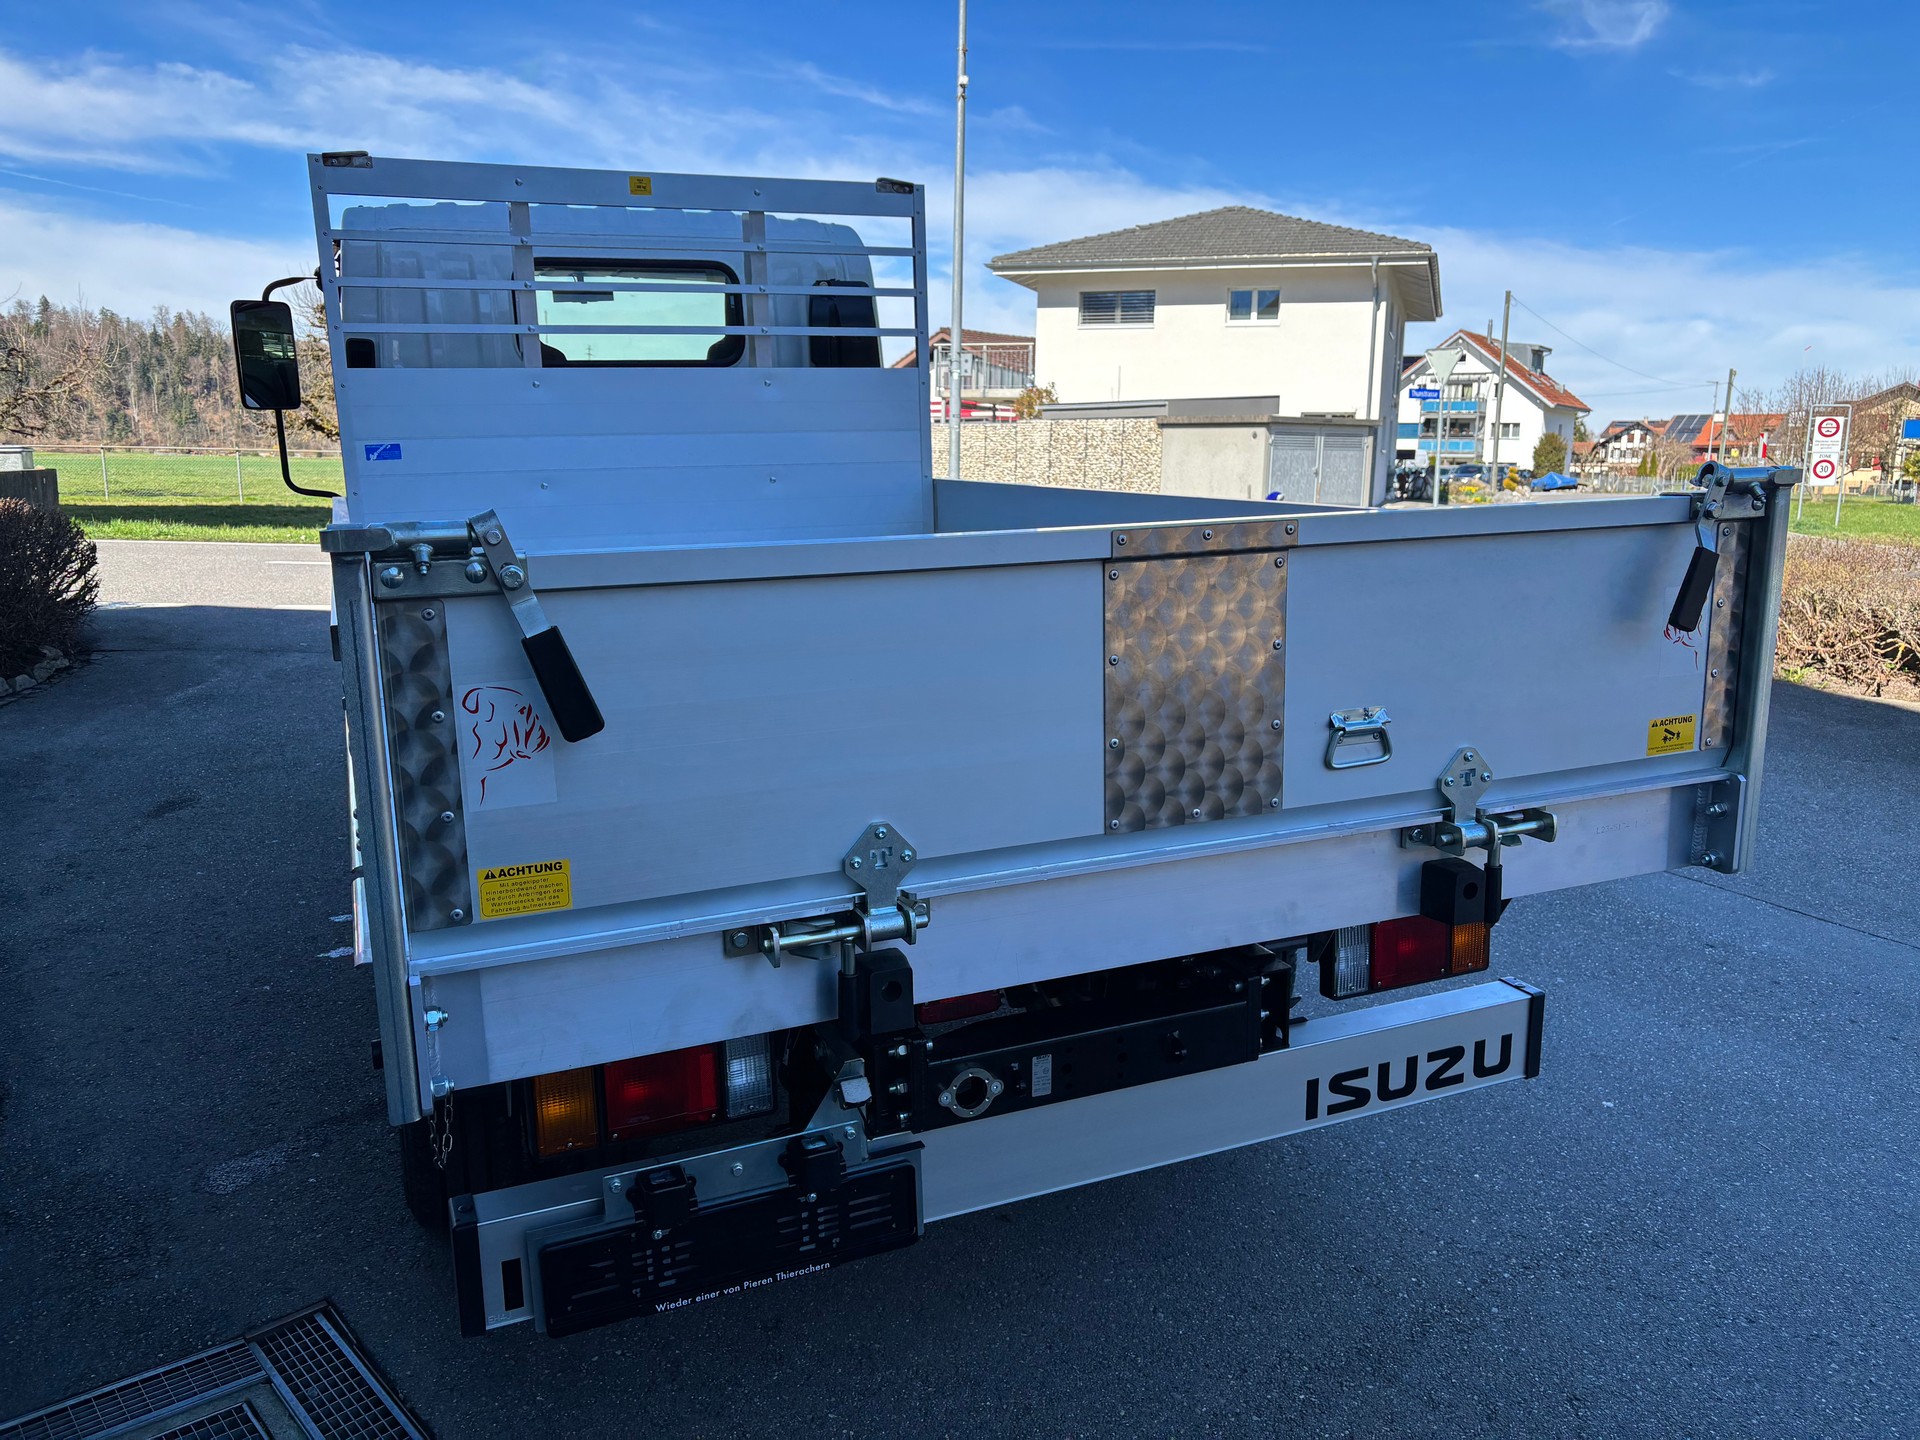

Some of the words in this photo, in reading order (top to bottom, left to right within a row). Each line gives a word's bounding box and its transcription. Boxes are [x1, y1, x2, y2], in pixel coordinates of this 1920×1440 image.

[1819, 465, 1829, 474] 30
[1659, 715, 1693, 727] ACHTUNG
[869, 846, 893, 870] T
[498, 861, 563, 878] ACHTUNG
[486, 885, 537, 896] Hinterbordwand
[518, 889, 551, 898] Anbringen
[490, 904, 521, 913] Fahrzeug
[522, 900, 561, 909] aufmerksam
[1305, 1033, 1513, 1121] ISUZU
[655, 1297, 692, 1312] Wieder
[695, 1290, 720, 1303] einer
[723, 1284, 741, 1295] von
[743, 1277, 773, 1290] Pieren
[776, 1261, 831, 1282] Thierachern
